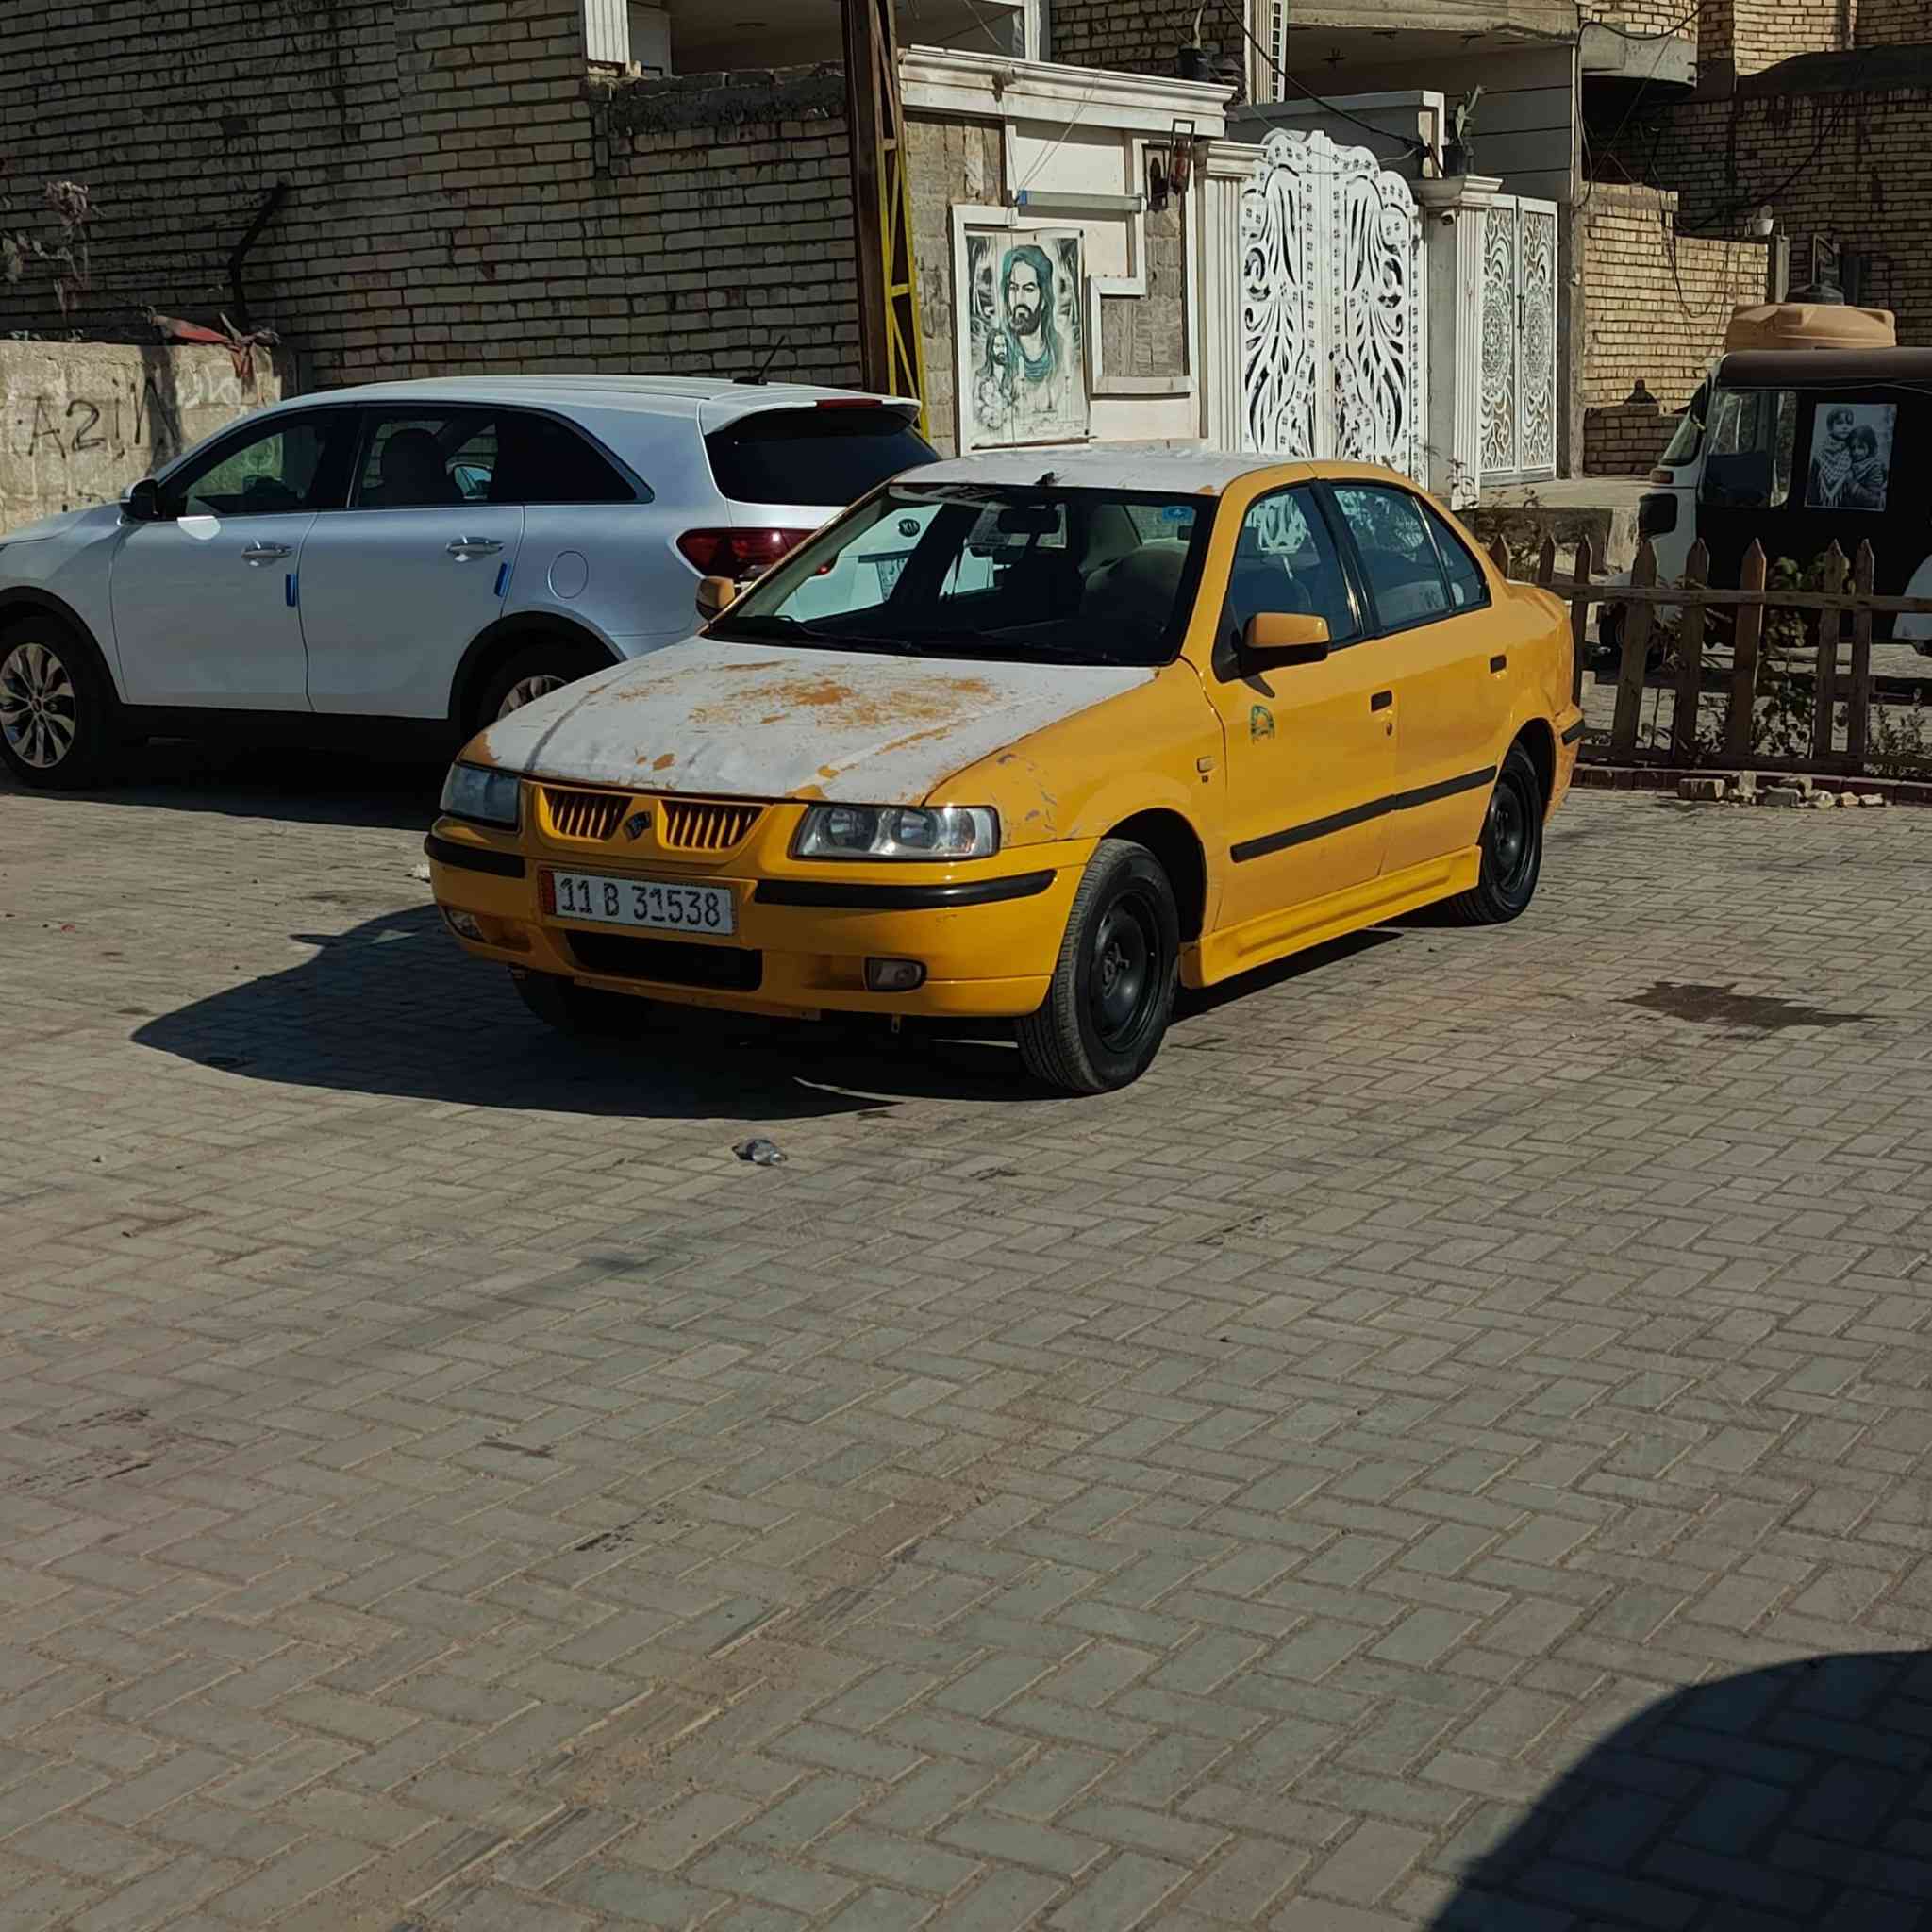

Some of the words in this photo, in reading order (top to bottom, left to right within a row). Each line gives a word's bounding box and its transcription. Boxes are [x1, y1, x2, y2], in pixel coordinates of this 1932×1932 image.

[559, 877, 593, 914] 11
[604, 882, 620, 917] B
[631, 885, 721, 927] 31538
